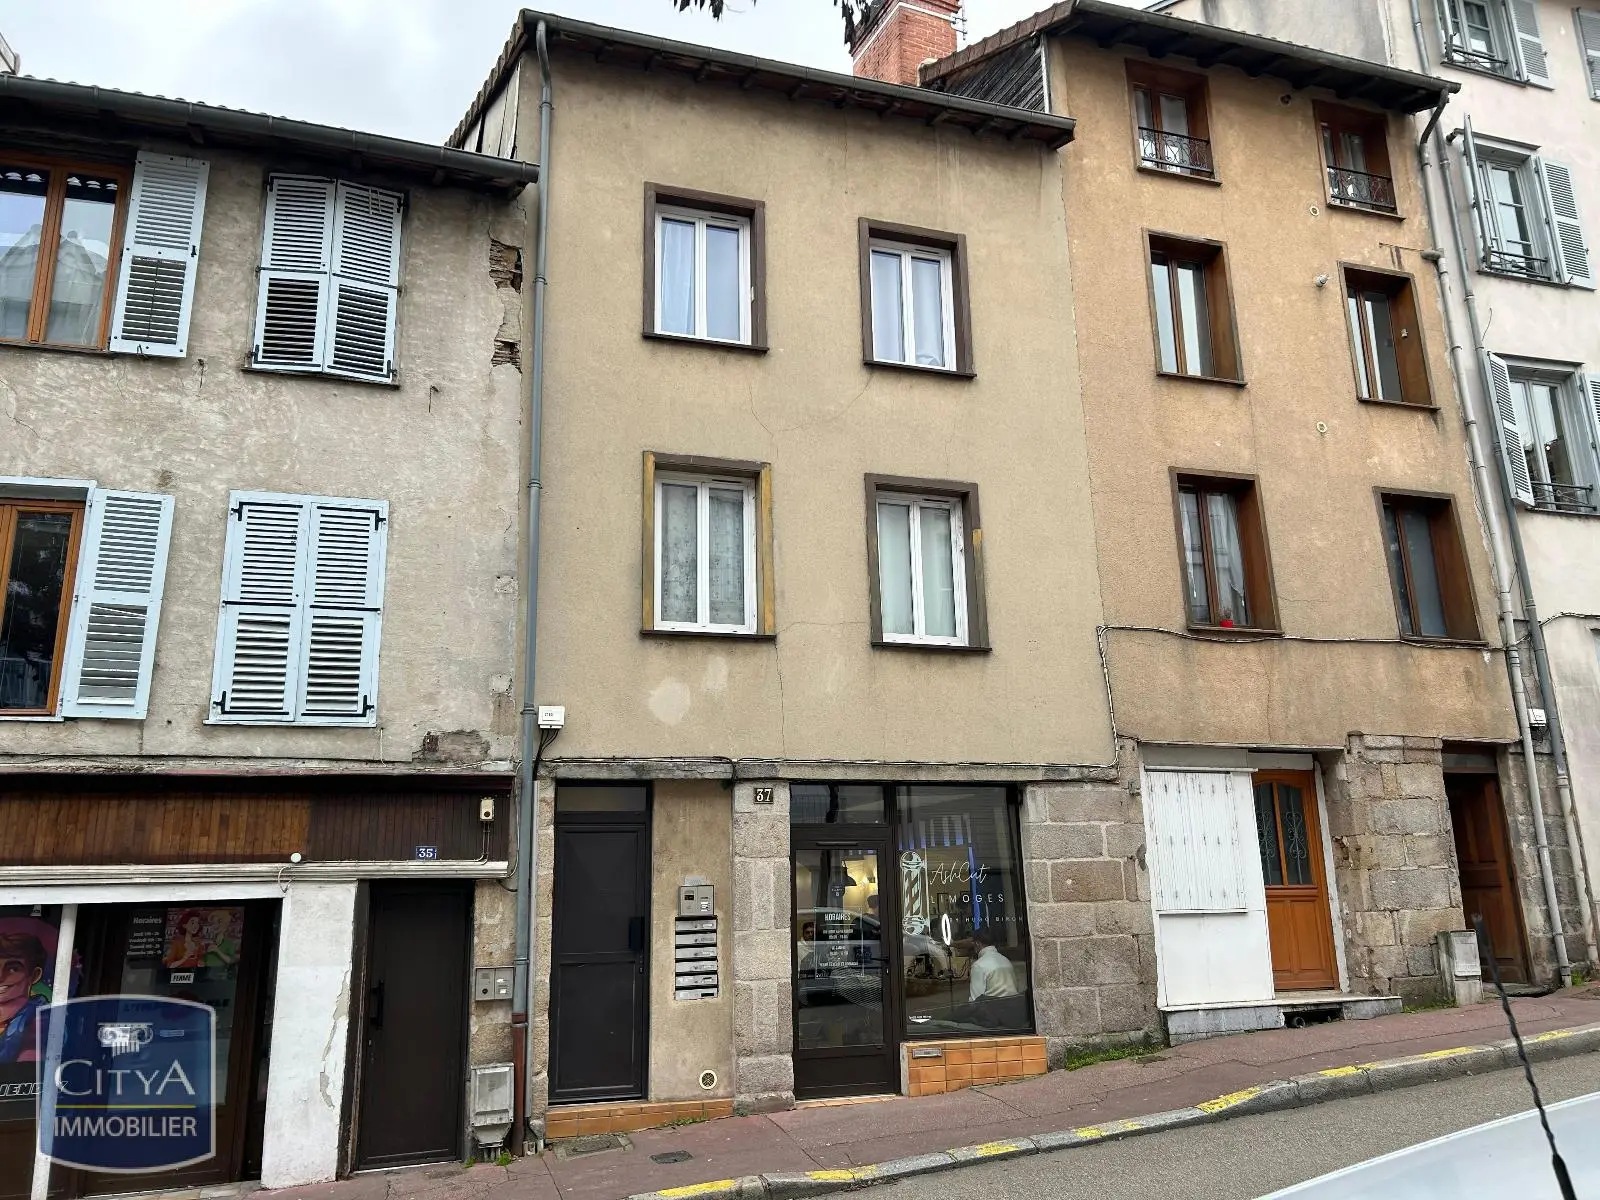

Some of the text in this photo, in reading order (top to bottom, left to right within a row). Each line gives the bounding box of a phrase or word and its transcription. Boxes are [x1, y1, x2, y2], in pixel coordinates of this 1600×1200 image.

[756, 788, 772, 802] 37
[418, 848, 433, 858] 35
[931, 893, 1004, 904] LIMOGES
[824, 913, 851, 921] HORAIRES
